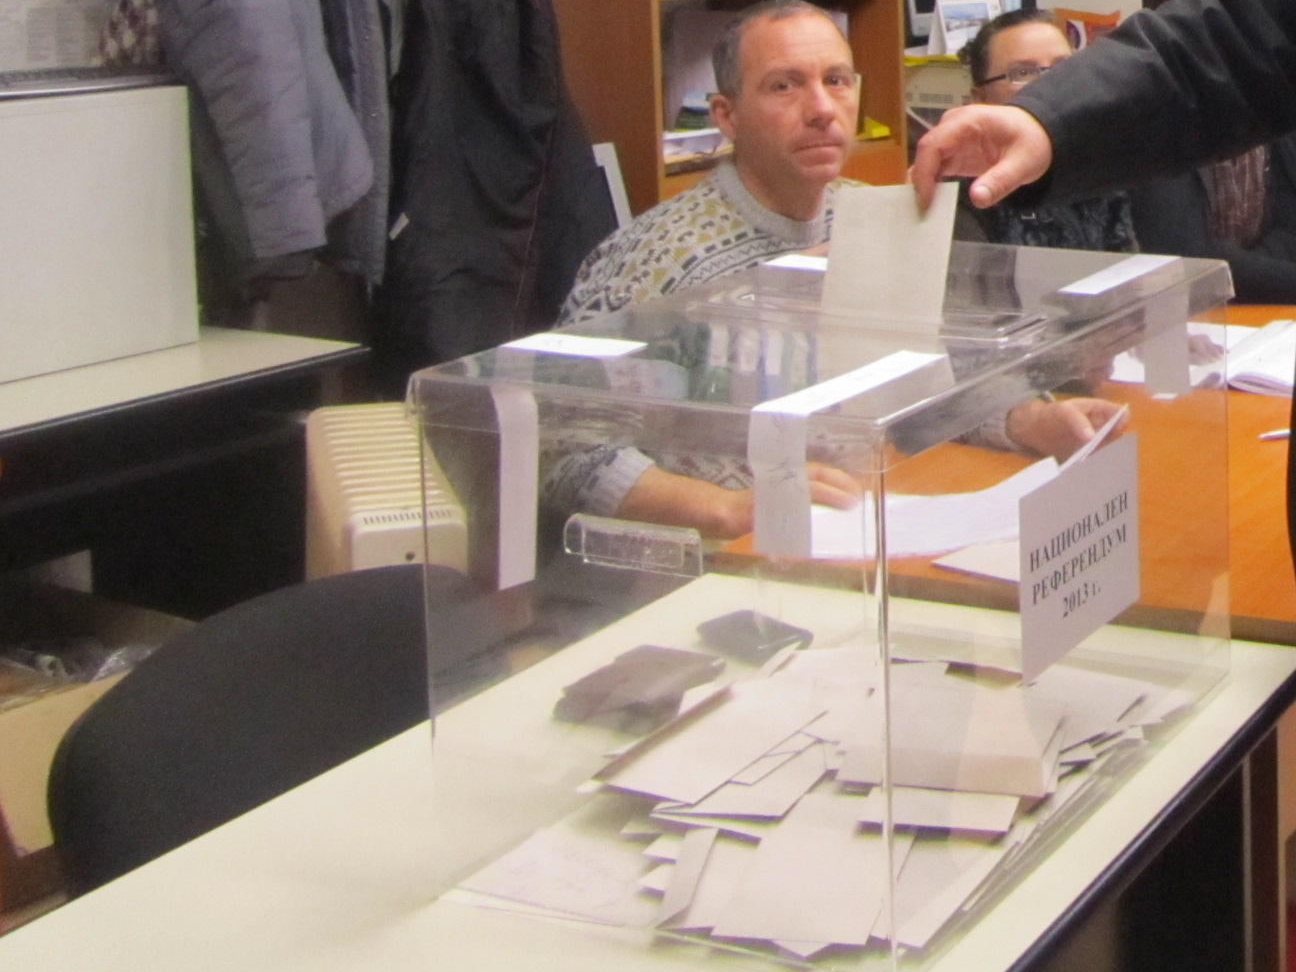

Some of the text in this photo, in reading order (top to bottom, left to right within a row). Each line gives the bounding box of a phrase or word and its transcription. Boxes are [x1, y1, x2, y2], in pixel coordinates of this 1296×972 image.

[1030, 491, 1128, 572] НАЦИОНАЛЕН
[1033, 523, 1127, 605] РЕФЕРЕНДУМ
[1063, 582, 1089, 618] 2013
